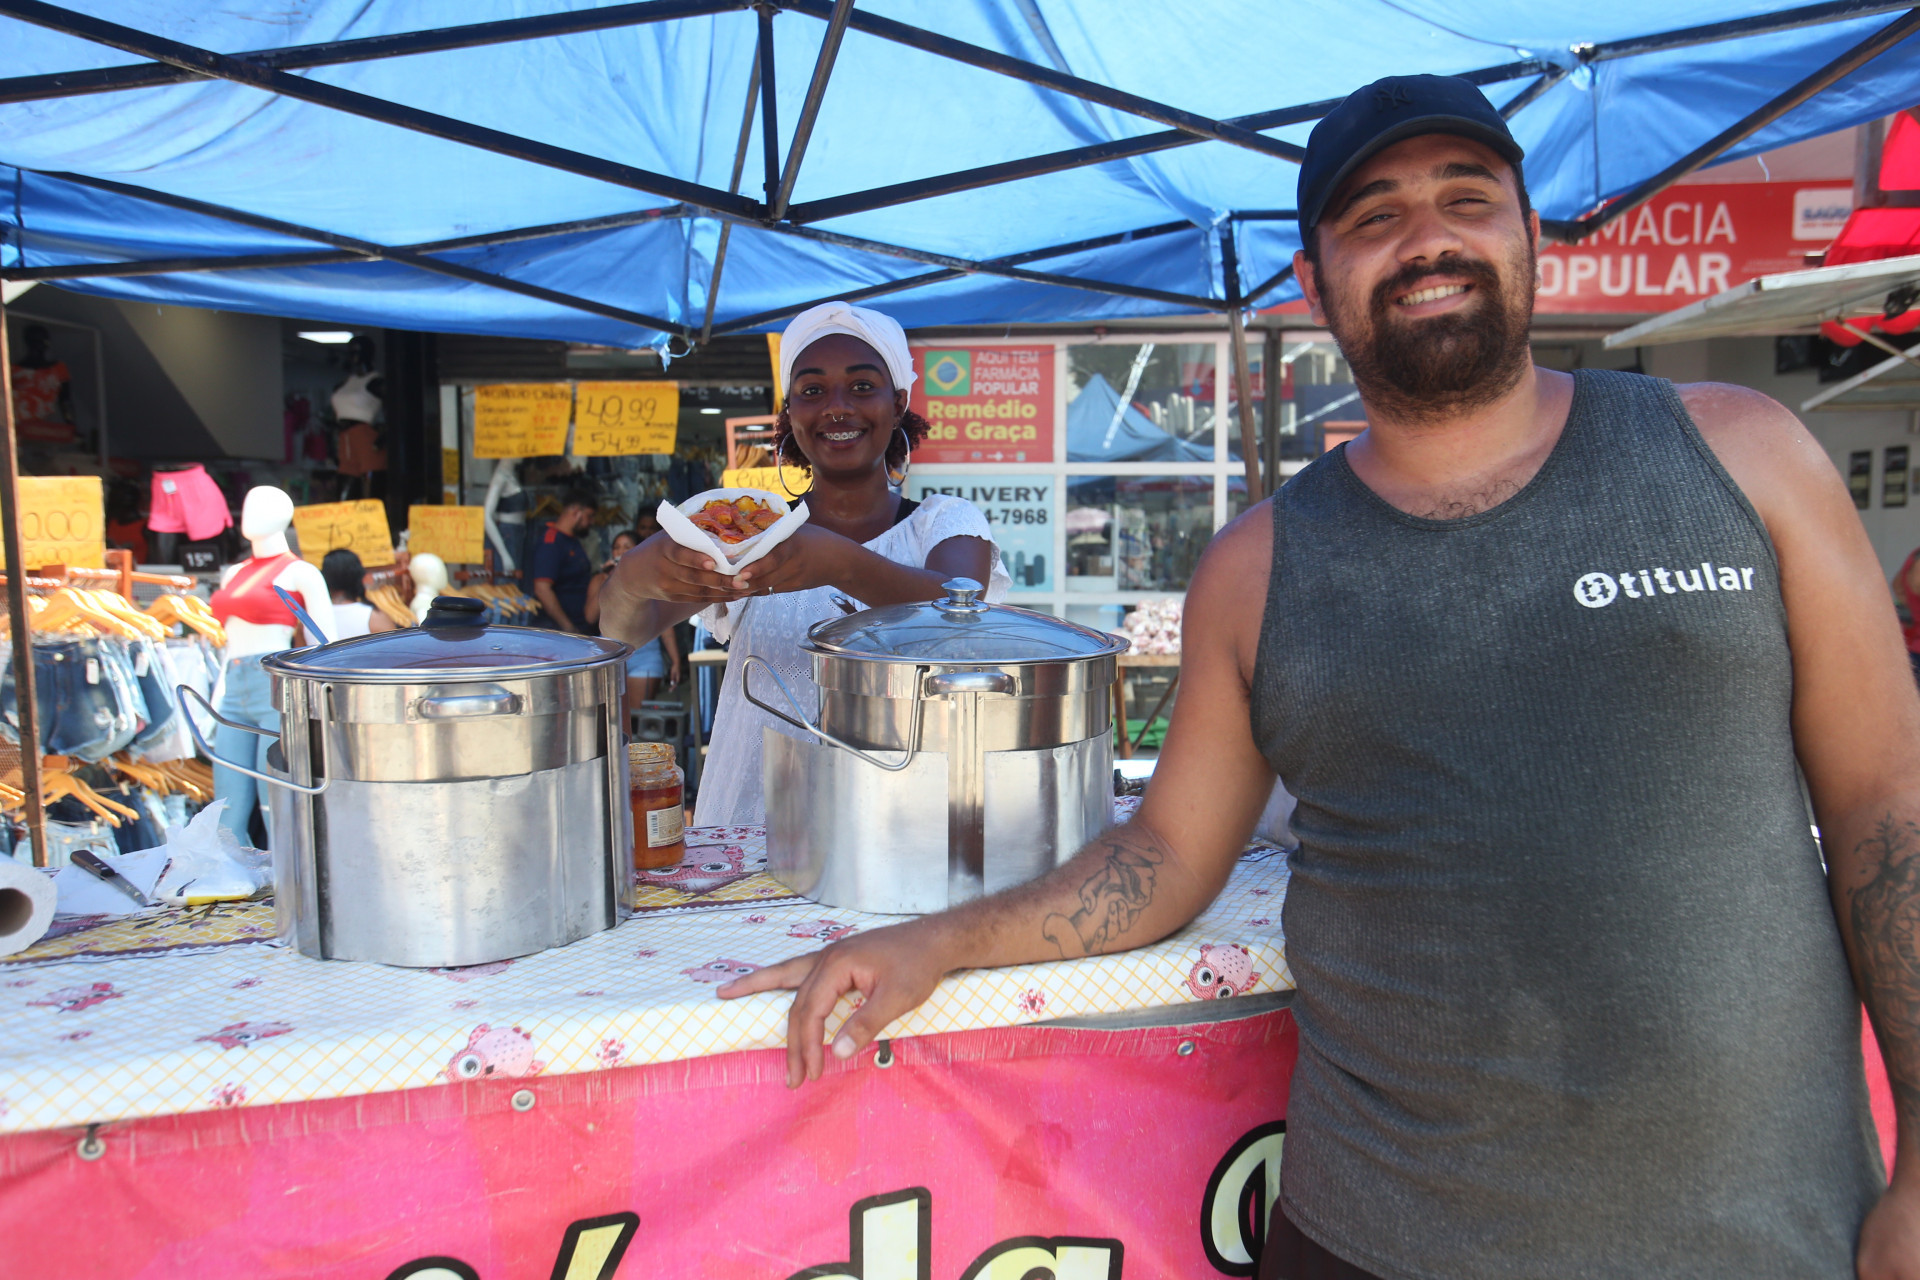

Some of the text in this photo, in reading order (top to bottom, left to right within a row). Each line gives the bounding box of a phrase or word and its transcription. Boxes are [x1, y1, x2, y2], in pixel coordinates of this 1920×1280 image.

[1536, 253, 1732, 297] OPULAR
[976, 350, 1039, 364] AQUI TEM
[974, 364, 1040, 380] FARMÁCIA
[973, 381, 1039, 395] POPULAR
[927, 400, 1037, 419] Remédio
[927, 421, 1036, 443] de Graça
[1619, 562, 1755, 599] titular
